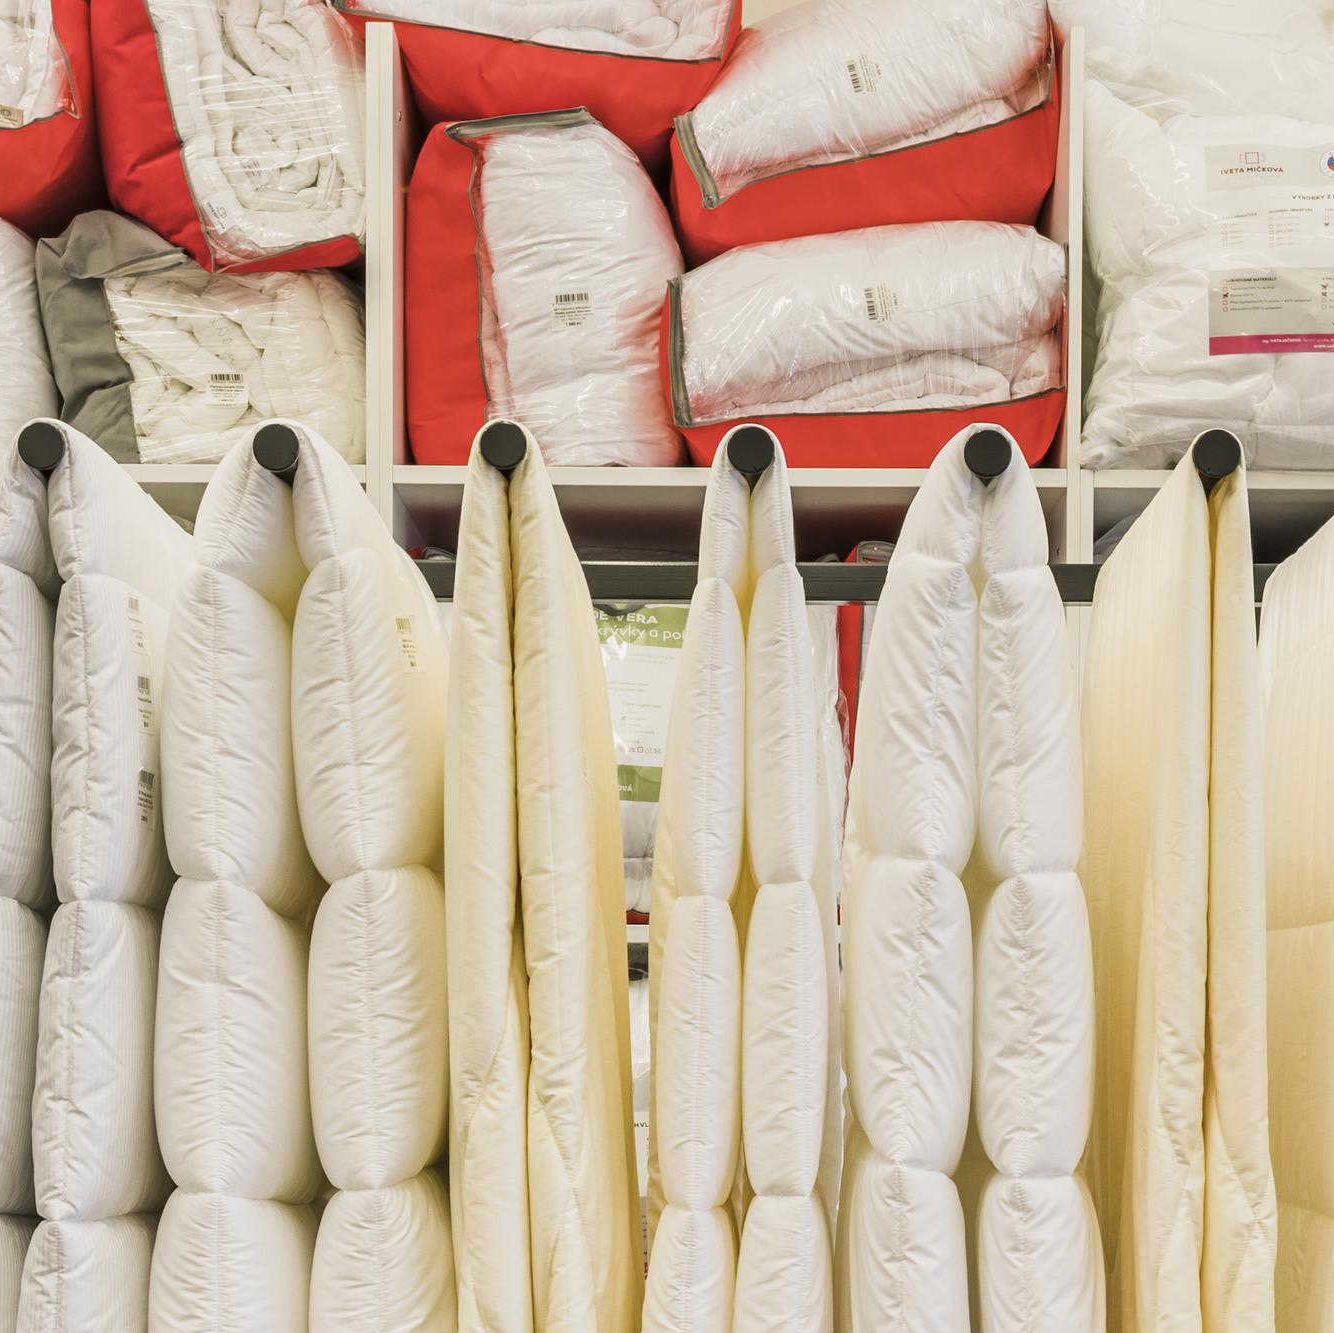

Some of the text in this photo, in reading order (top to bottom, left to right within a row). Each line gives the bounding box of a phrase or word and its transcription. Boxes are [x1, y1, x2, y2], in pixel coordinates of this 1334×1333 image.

[1221, 165, 1284, 175] IVETA MIČKOVÁ
[649, 629, 658, 638] a
